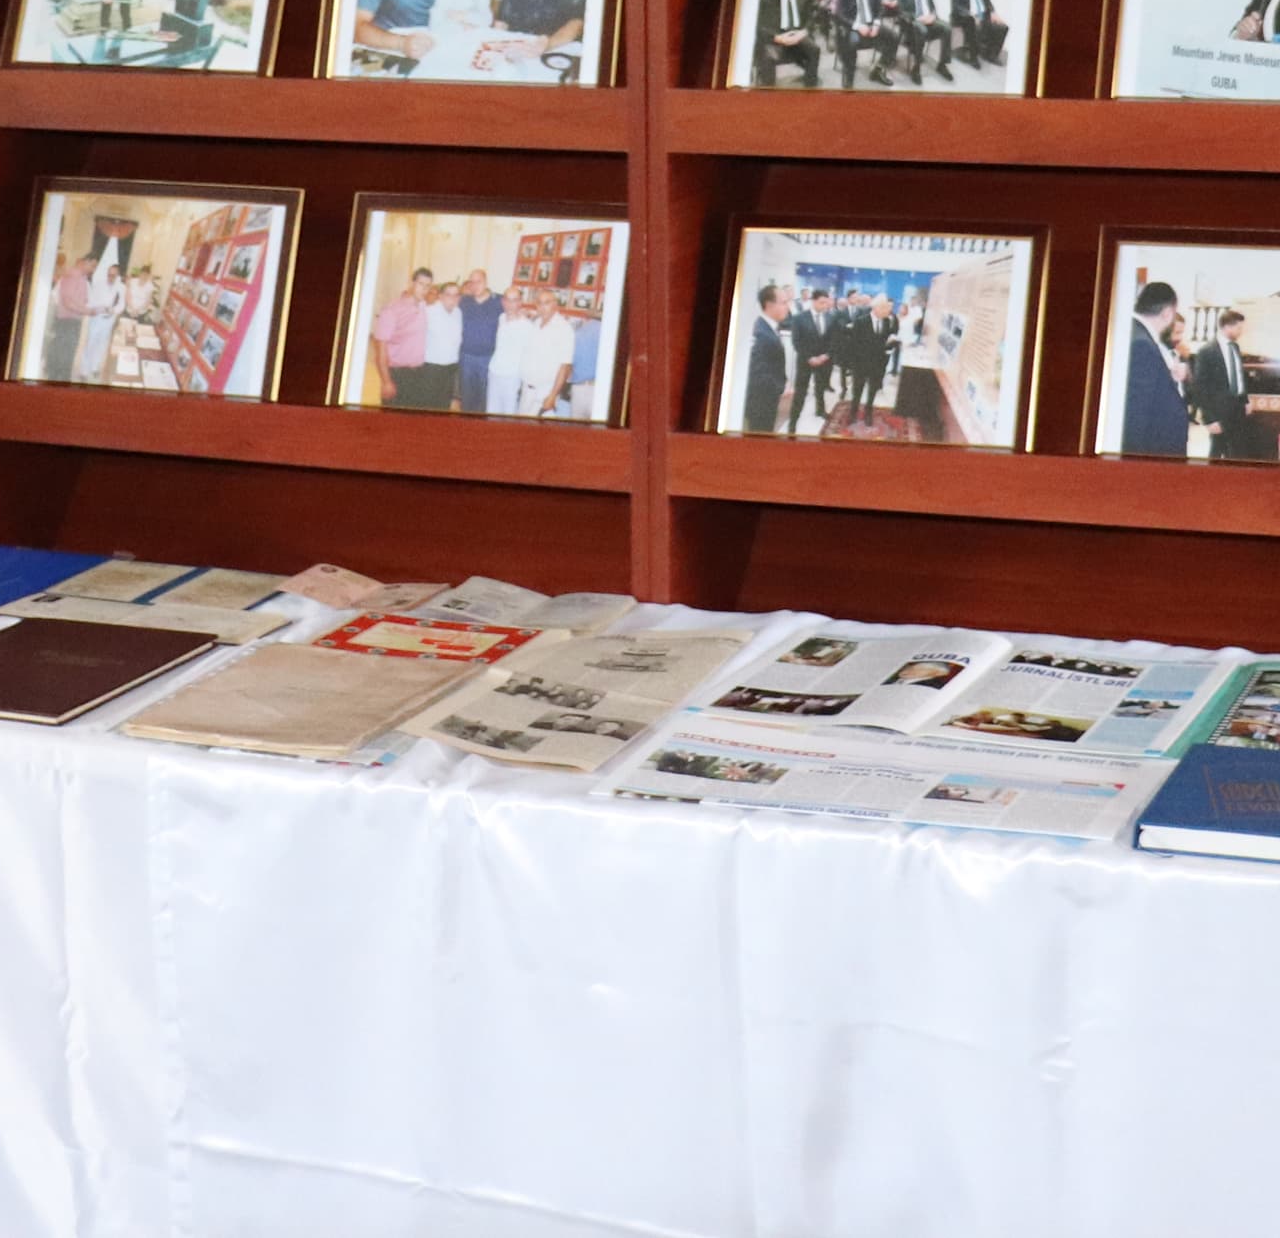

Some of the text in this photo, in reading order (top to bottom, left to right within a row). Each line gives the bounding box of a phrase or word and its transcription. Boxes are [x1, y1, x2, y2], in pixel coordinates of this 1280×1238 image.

[1171, 44, 1215, 62] Mountain
[1216, 49, 1242, 64] Jews
[1210, 75, 1238, 91] GUBA
